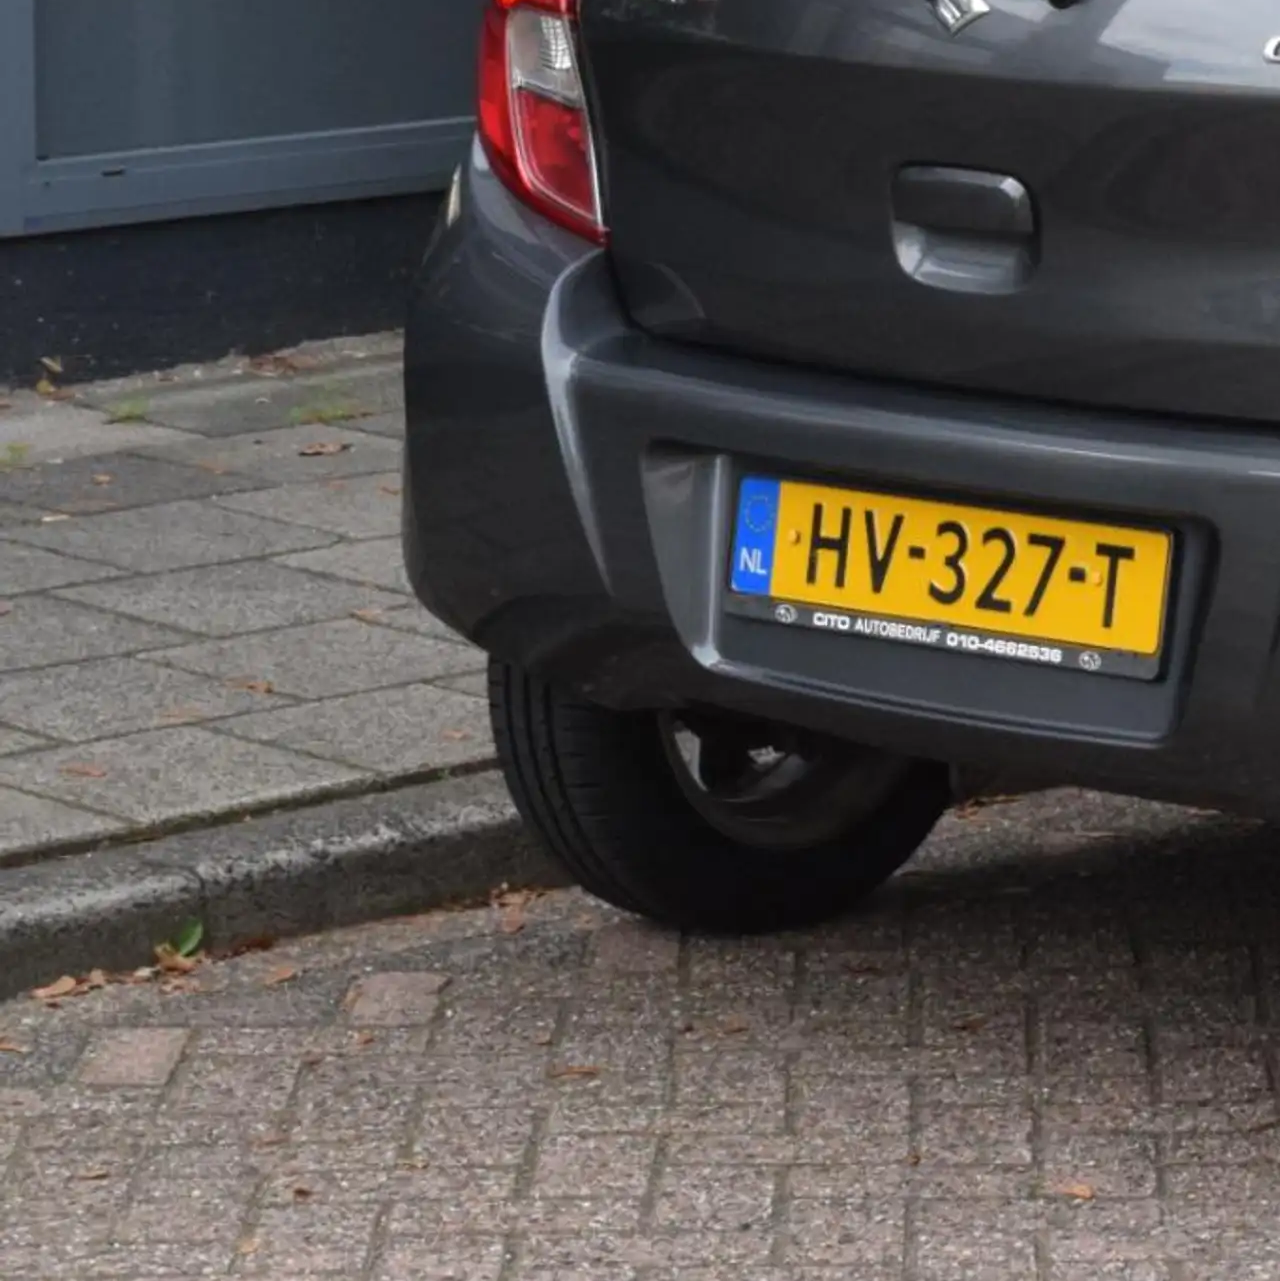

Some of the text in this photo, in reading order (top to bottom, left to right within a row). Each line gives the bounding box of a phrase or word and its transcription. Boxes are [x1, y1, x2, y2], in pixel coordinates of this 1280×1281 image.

[739, 546, 768, 576] NL
[806, 502, 1136, 629] HV-327-T
[813, 611, 851, 631] CITO
[853, 616, 941, 644] AUTOBEDRIJF
